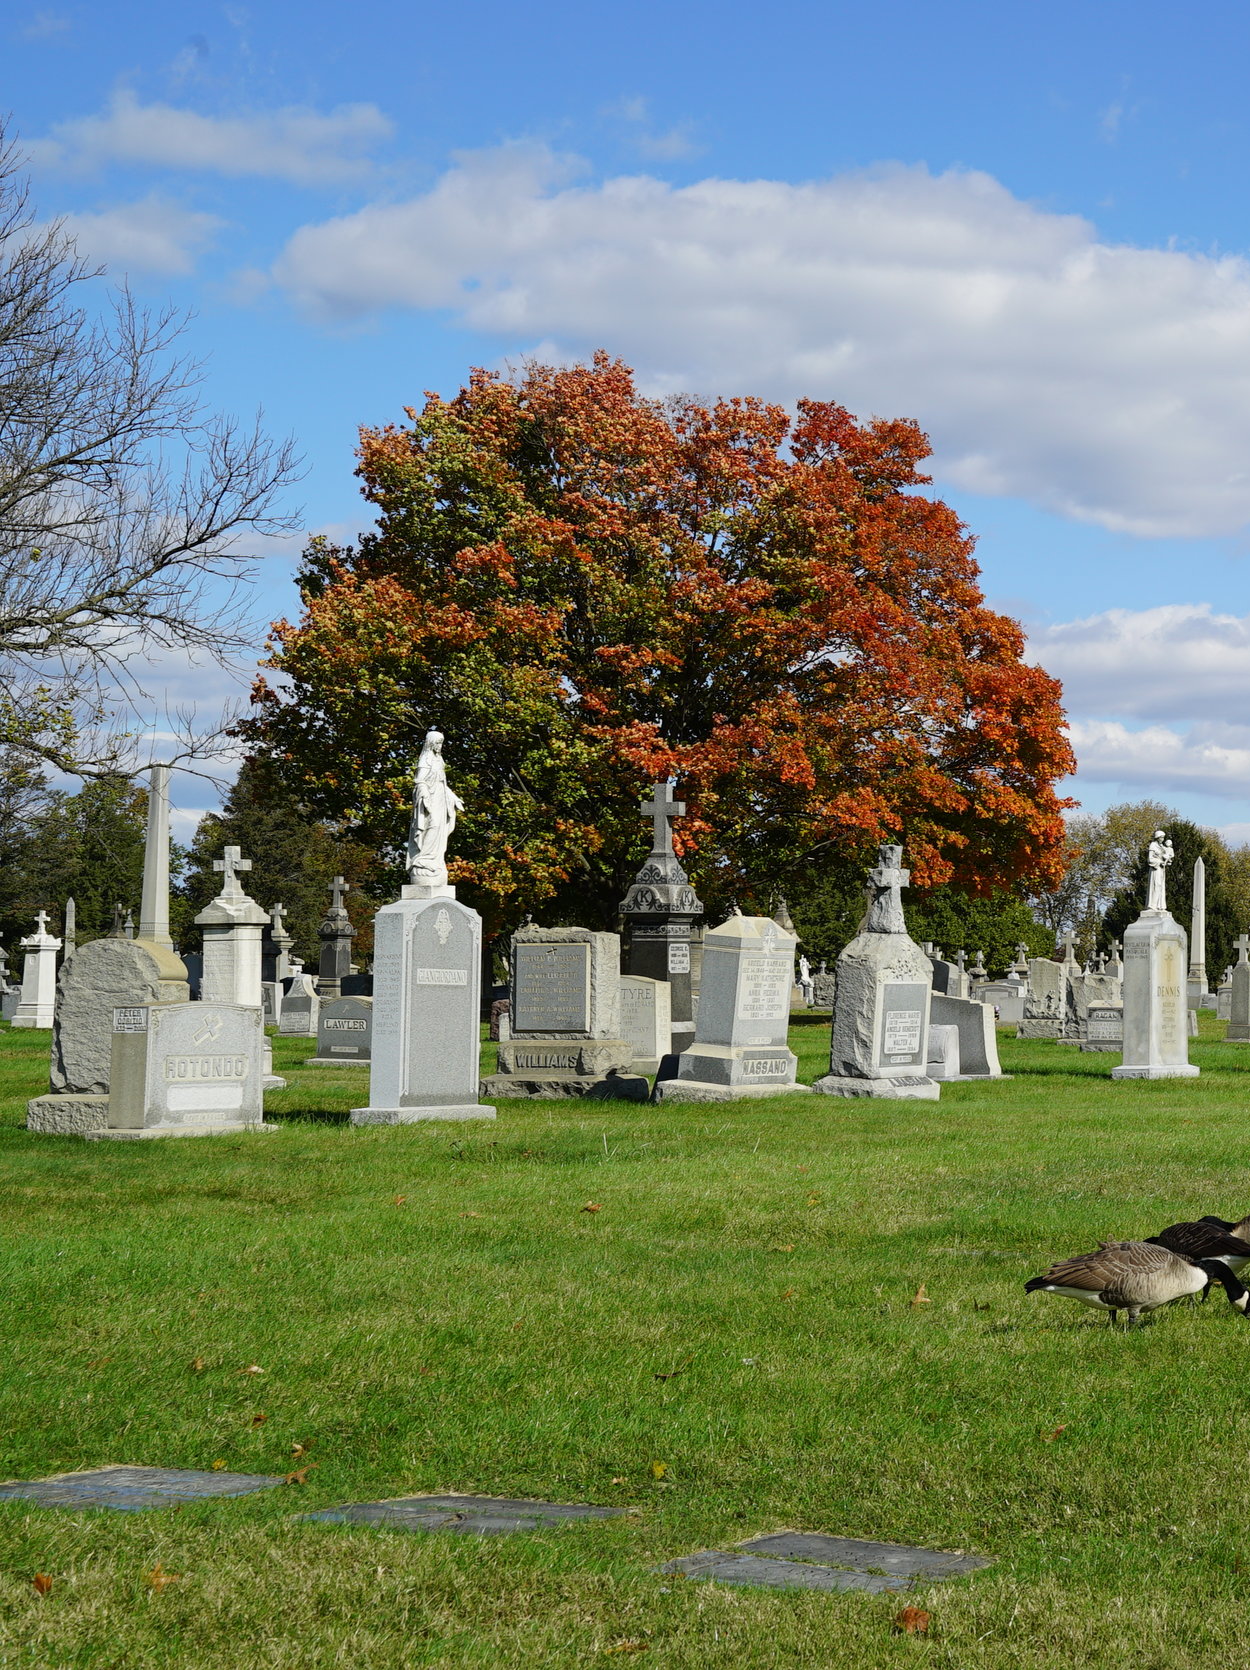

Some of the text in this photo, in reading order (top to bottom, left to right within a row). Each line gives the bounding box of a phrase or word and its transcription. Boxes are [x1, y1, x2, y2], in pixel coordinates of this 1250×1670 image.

[1157, 986, 1180, 997] DENNIS
[325, 1020, 366, 1030] LAWLER
[515, 1053, 578, 1069] WILLIAMS
[165, 1057, 245, 1079] ROTONDO
